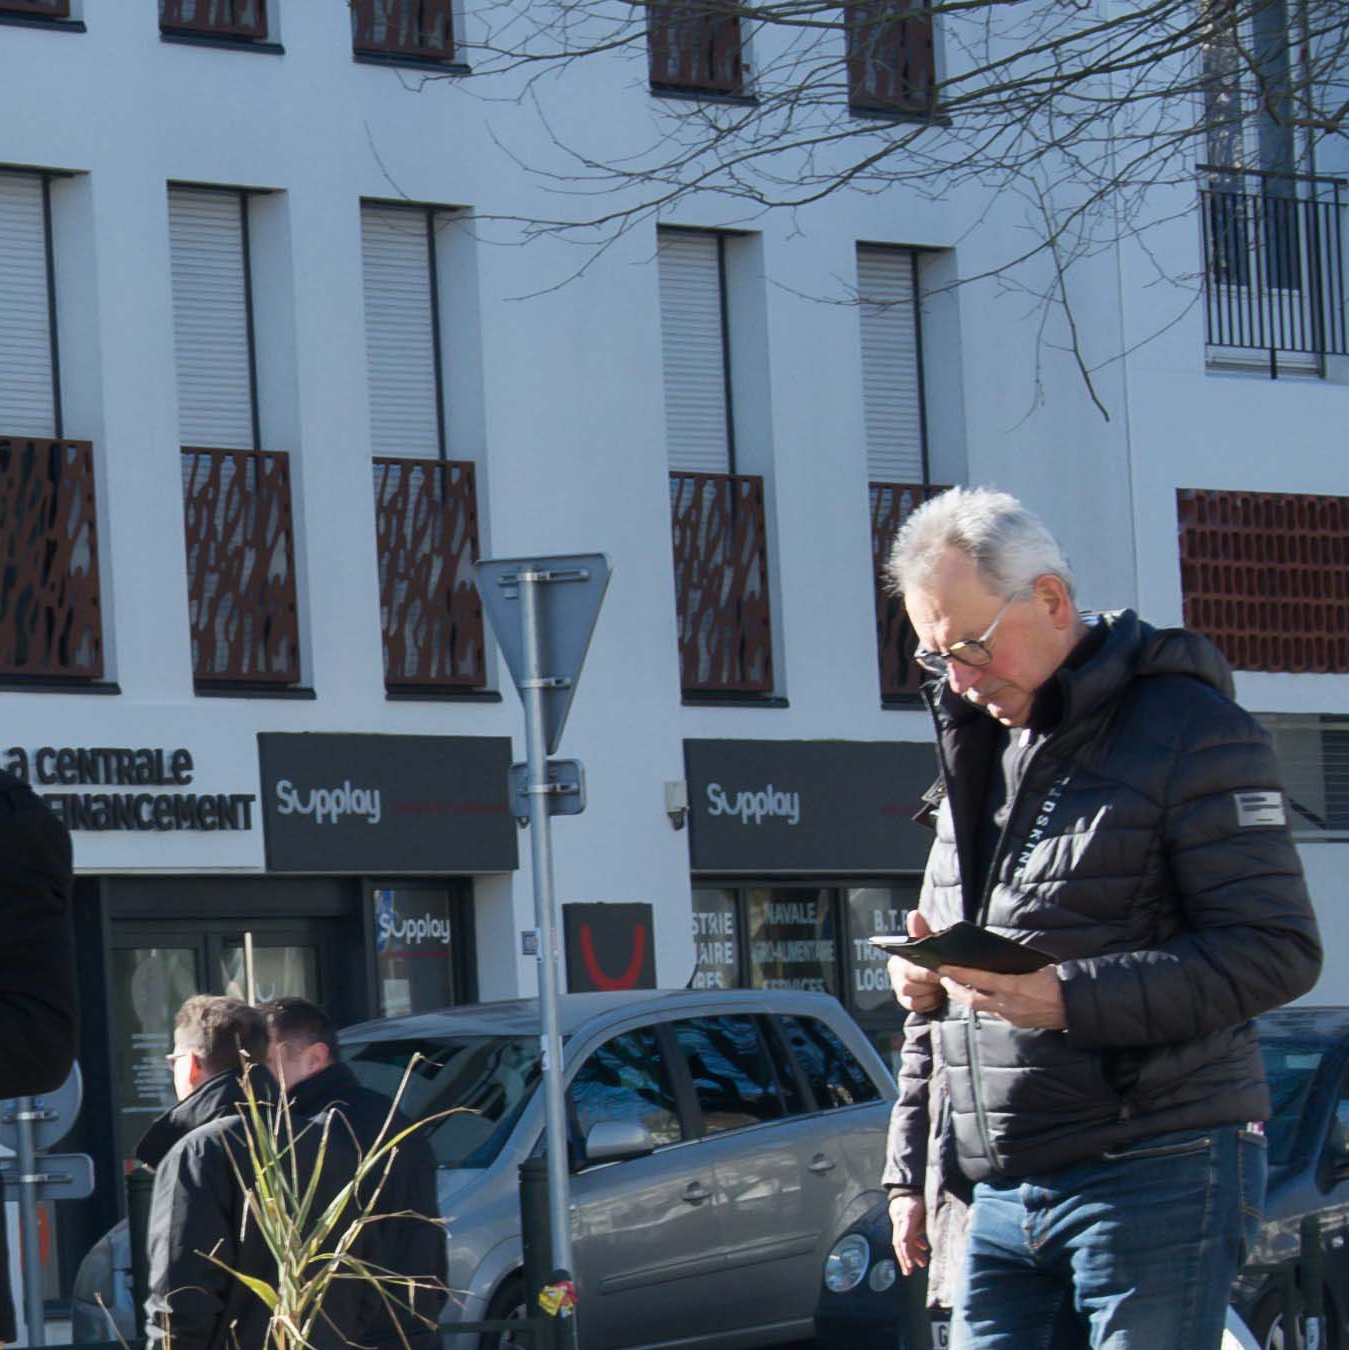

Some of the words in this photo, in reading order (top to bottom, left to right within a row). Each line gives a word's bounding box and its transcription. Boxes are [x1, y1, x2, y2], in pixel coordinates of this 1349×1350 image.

[275, 778, 382, 825] Supplay
[706, 782, 800, 825] Supplay
[379, 912, 451, 945] Supplay
